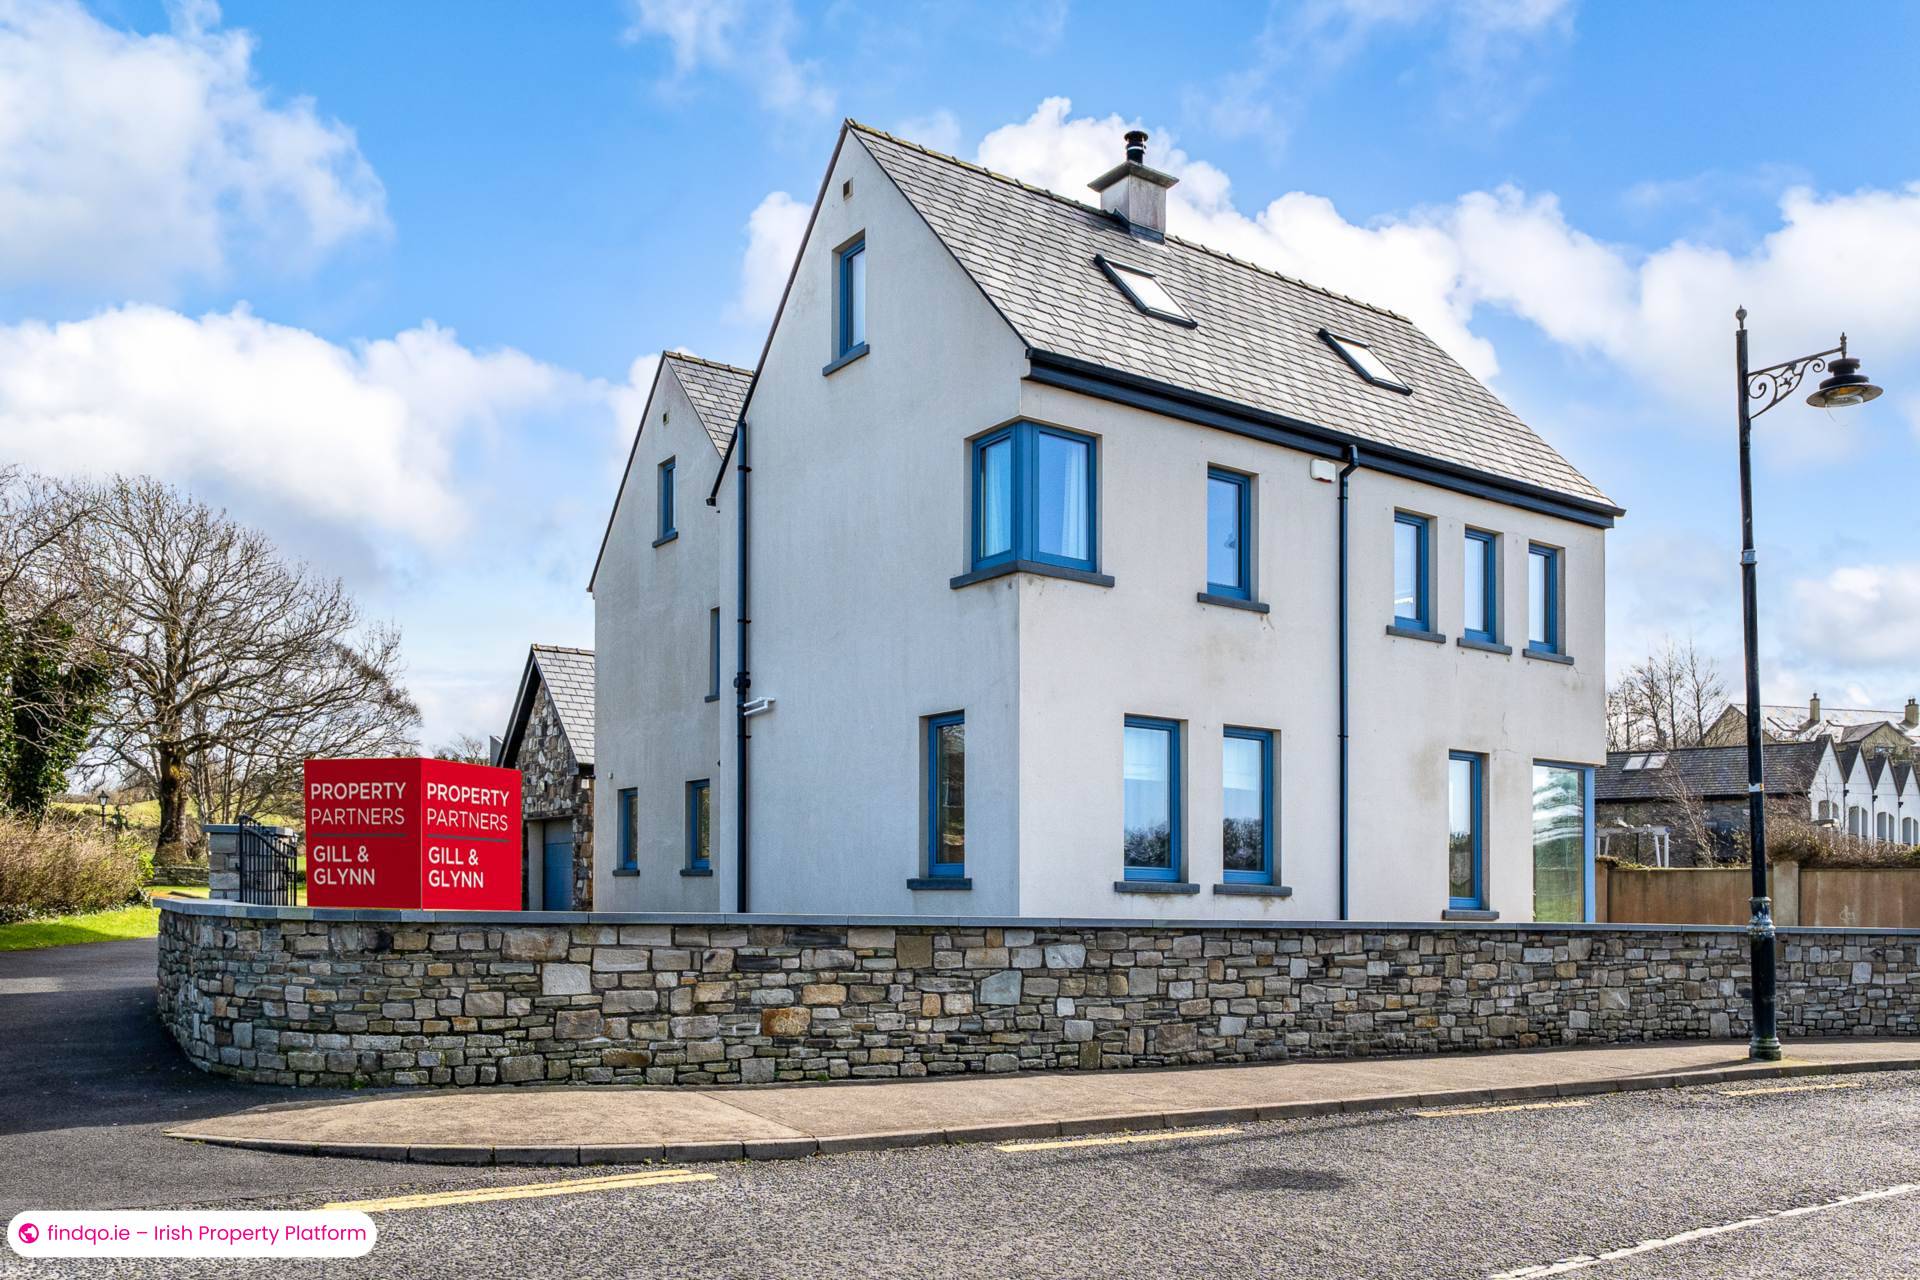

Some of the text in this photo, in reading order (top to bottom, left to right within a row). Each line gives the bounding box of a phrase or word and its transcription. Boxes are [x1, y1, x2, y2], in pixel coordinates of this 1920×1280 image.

[310, 782, 407, 800] PROPERTY
[426, 782, 510, 807] PROPERTY
[311, 807, 405, 825] PARTNERS
[426, 807, 509, 832] PARTNERS
[313, 845, 369, 863] GILL &
[428, 846, 479, 866] GILL &
[313, 867, 375, 886] GLYNN
[428, 869, 484, 889] GLYNN
